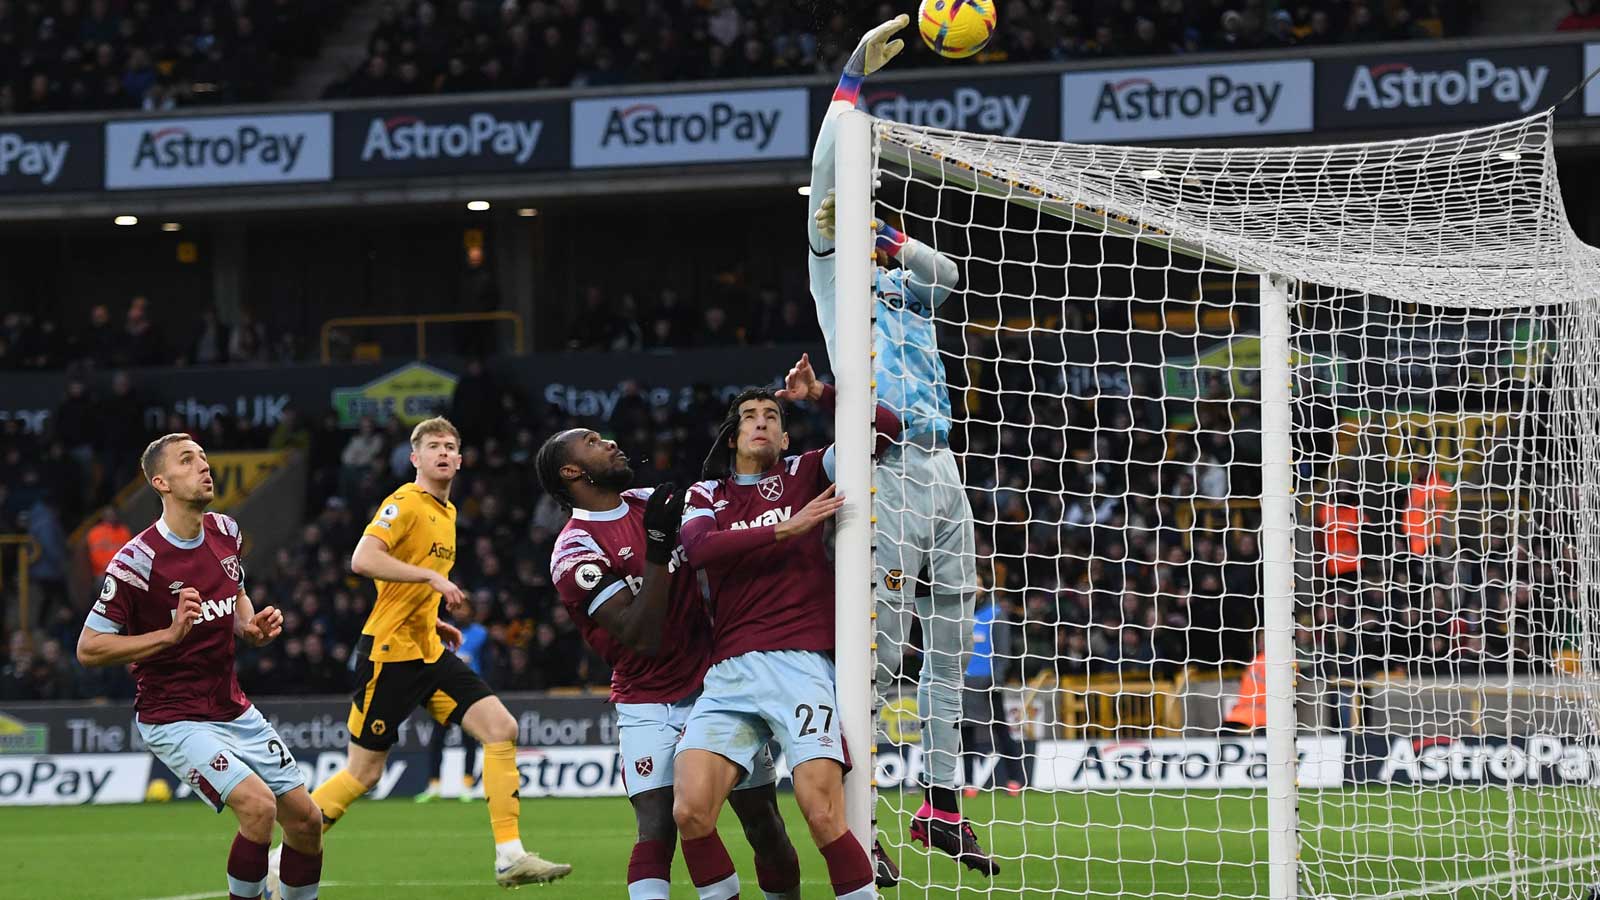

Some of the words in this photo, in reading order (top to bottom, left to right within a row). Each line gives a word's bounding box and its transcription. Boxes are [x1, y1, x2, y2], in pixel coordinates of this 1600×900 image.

[1091, 75, 1282, 124] AstroPay
[1344, 58, 1549, 113] AstroPay
[132, 125, 305, 174] AstroPay
[361, 112, 543, 165] AstroPay
[600, 102, 783, 151] AstroPay
[66, 718, 126, 752] The
[517, 711, 592, 746] floor
[795, 703, 834, 738] 27
